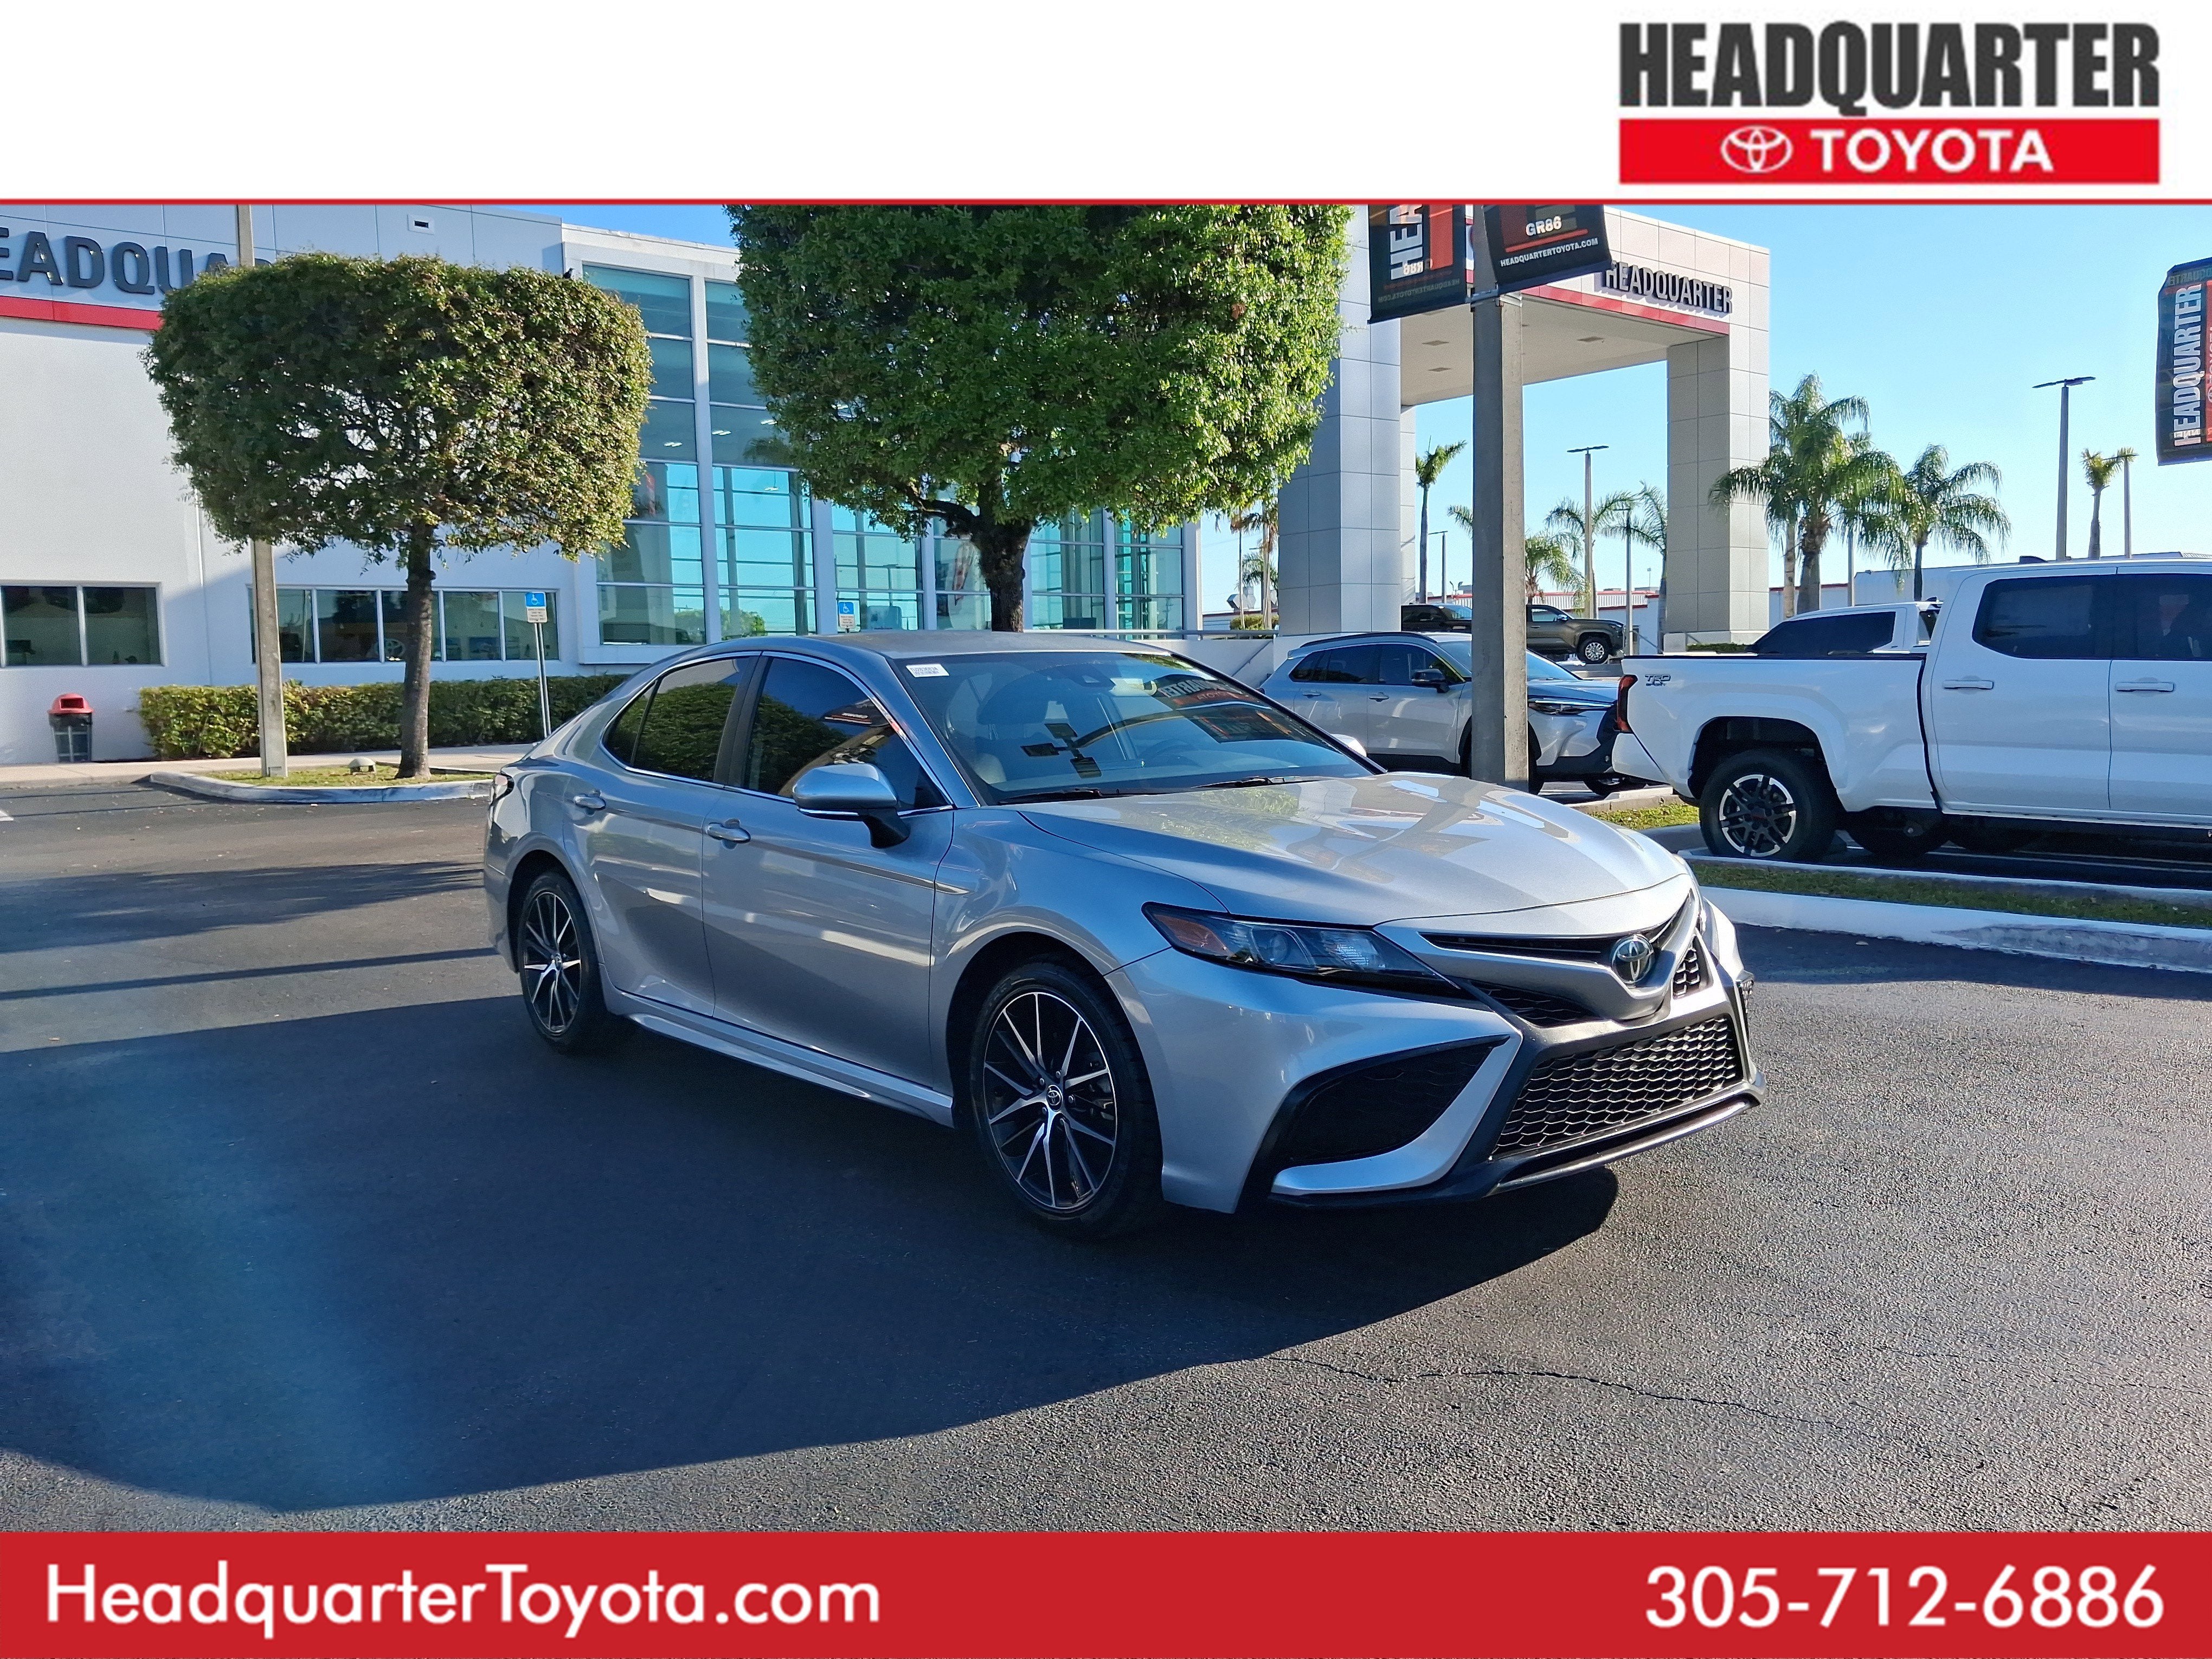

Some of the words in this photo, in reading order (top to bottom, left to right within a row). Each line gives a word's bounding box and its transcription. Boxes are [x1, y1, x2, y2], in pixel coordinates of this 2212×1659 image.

[1526, 216, 1562, 236] GR86
[1500, 237, 1598, 267] HEADQUARTERTOYOTA.COM
[1605, 260, 1733, 314] HEADQUARTER
[2173, 284, 2205, 446] HEADQUARTER
[1645, 674, 1671, 684] TRD
